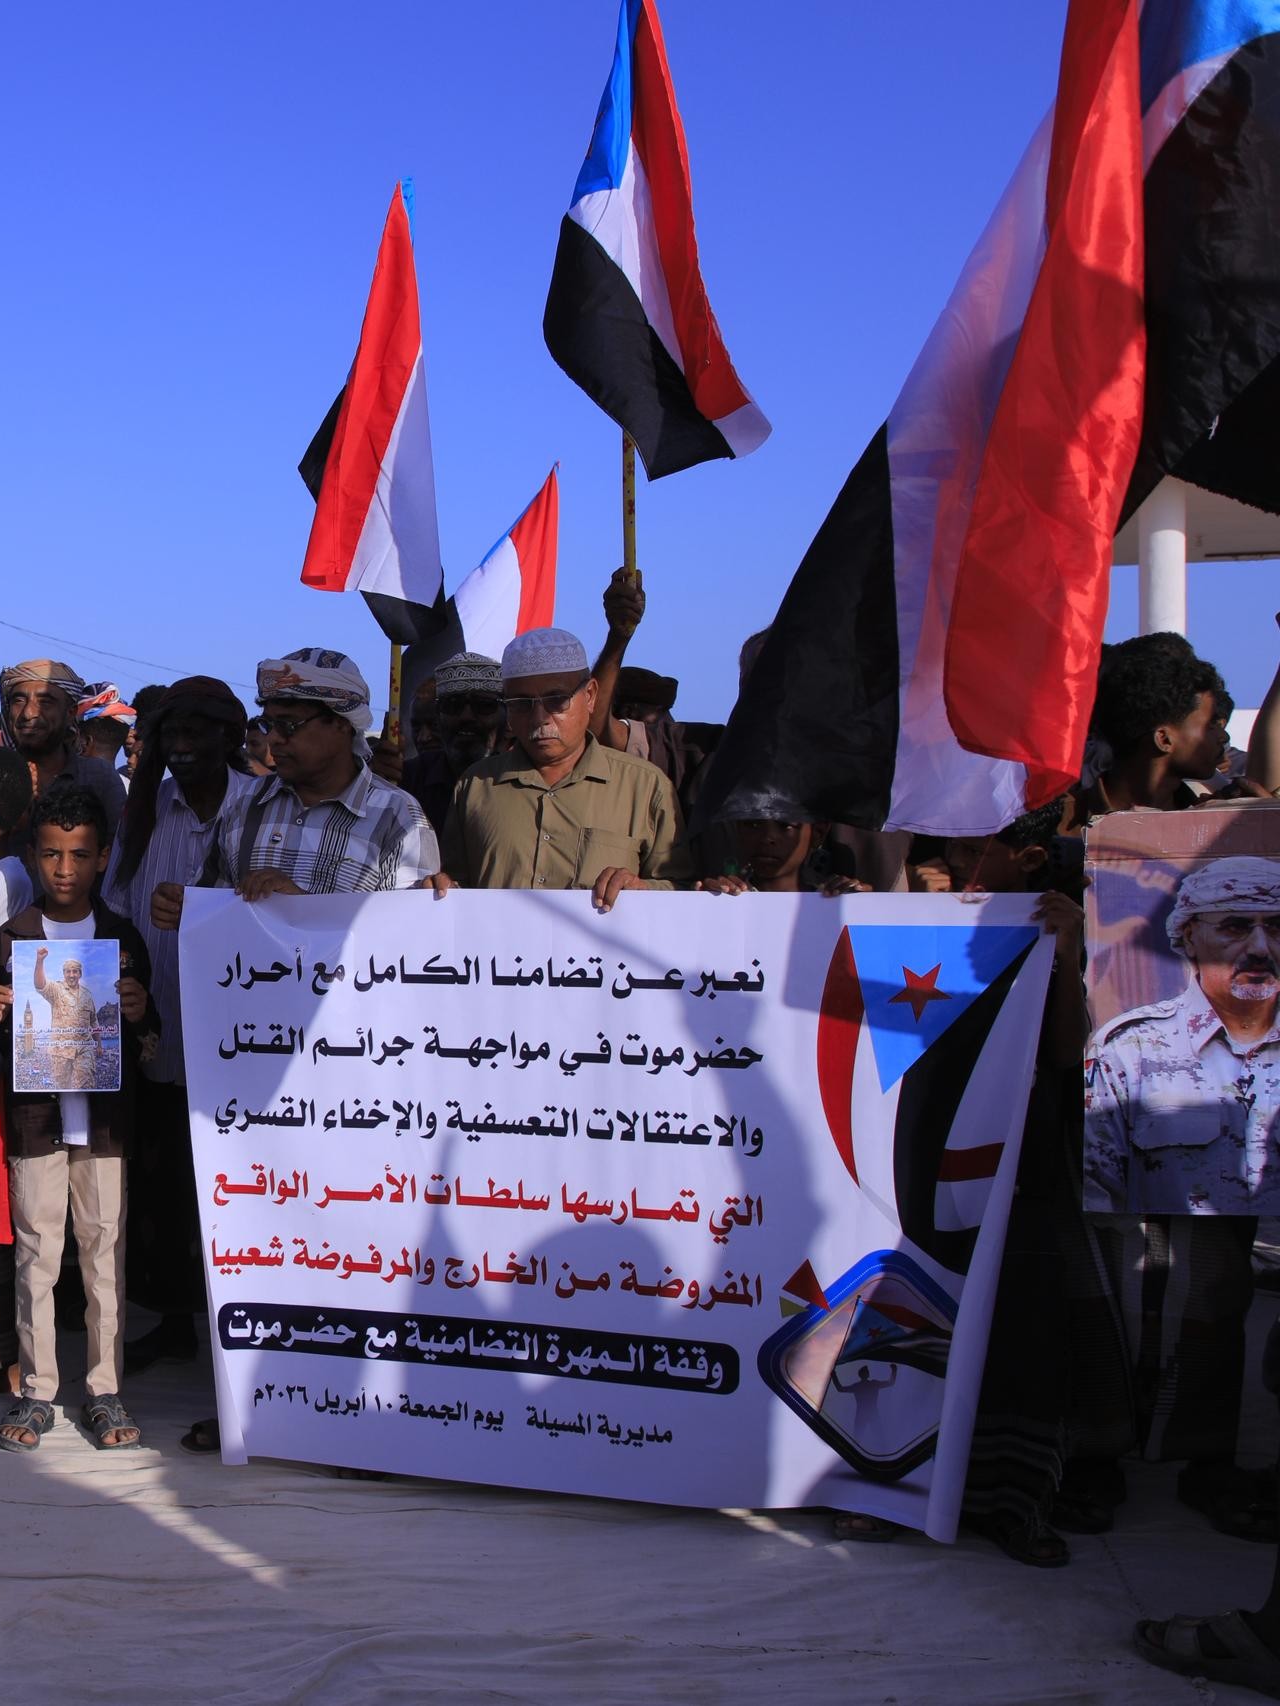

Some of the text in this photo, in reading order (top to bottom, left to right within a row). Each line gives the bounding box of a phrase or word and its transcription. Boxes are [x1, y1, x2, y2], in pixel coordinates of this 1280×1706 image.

[218, 950, 303, 991] أحرار
[312, 962, 346, 996] مع
[354, 955, 481, 993] الكامل
[612, 963, 686, 1000] عن
[690, 959, 765, 1001] نعبر
[219, 1024, 764, 1077] حضرموت في مواجهة جرائم القتل
[215, 1097, 764, 1158] والاعتقالات التعسفية والإخفاء القسري
[214, 1163, 762, 1244] التي تمارسها سلطات الأمر الواقع
[292, 1237, 435, 1284] والمرفوضة
[446, 1253, 546, 1289] الخارج
[556, 1268, 610, 1299] من
[620, 1262, 762, 1310] المفروضة
[228, 1310, 723, 1389] وقفة المهرة التضامنية مع حضرموت
[315, 1388, 366, 1418] أبريل
[399, 1394, 469, 1427] الجمعة
[474, 1410, 505, 1433] يوم
[526, 1406, 592, 1438] المسيلة
[597, 1414, 673, 1448] مديرية
